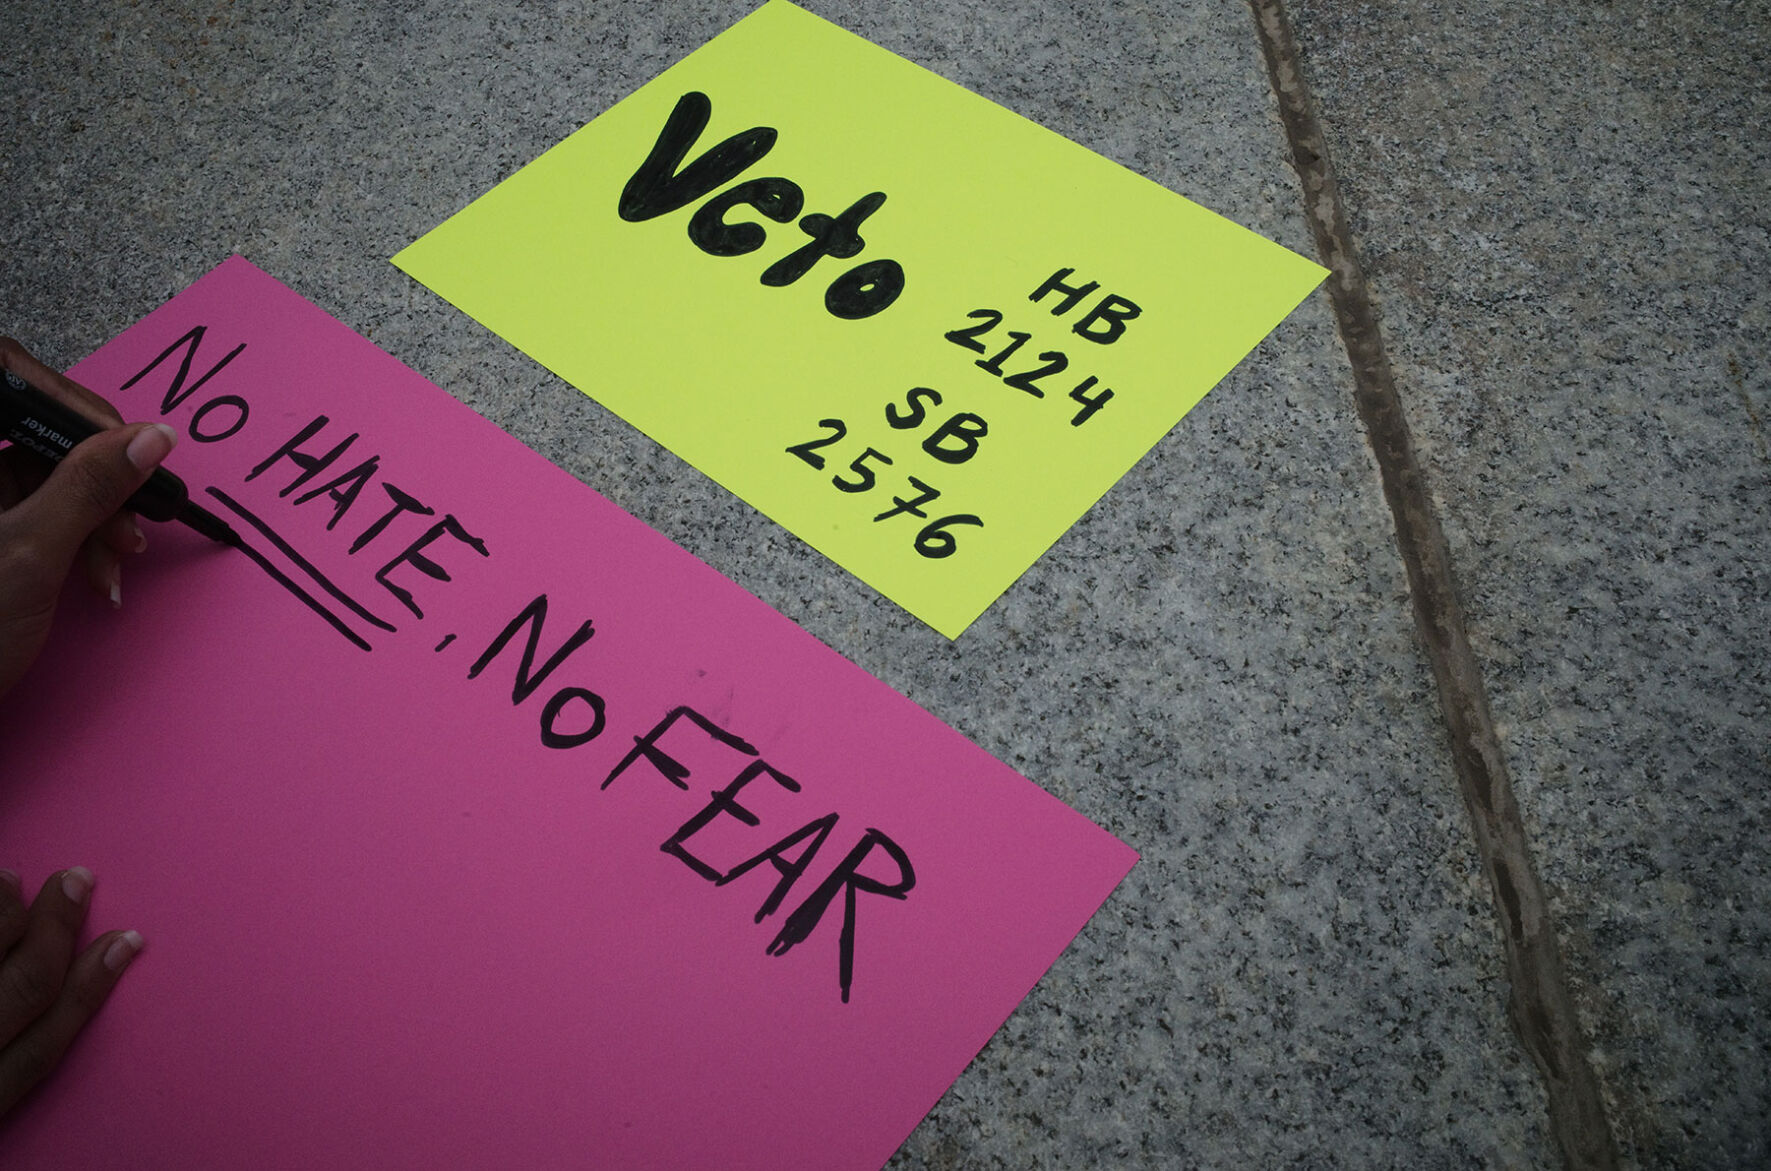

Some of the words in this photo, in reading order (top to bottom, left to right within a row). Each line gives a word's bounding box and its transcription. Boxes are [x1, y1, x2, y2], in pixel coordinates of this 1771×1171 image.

[617, 91, 906, 320] Veto
[1028, 267, 1143, 345] HB
[885, 387, 988, 465] SB
[944, 308, 1115, 427] 2124
[20, 416, 73, 449] marker
[785, 418, 984, 559] 2576
[600, 705, 917, 1005] FEAR
